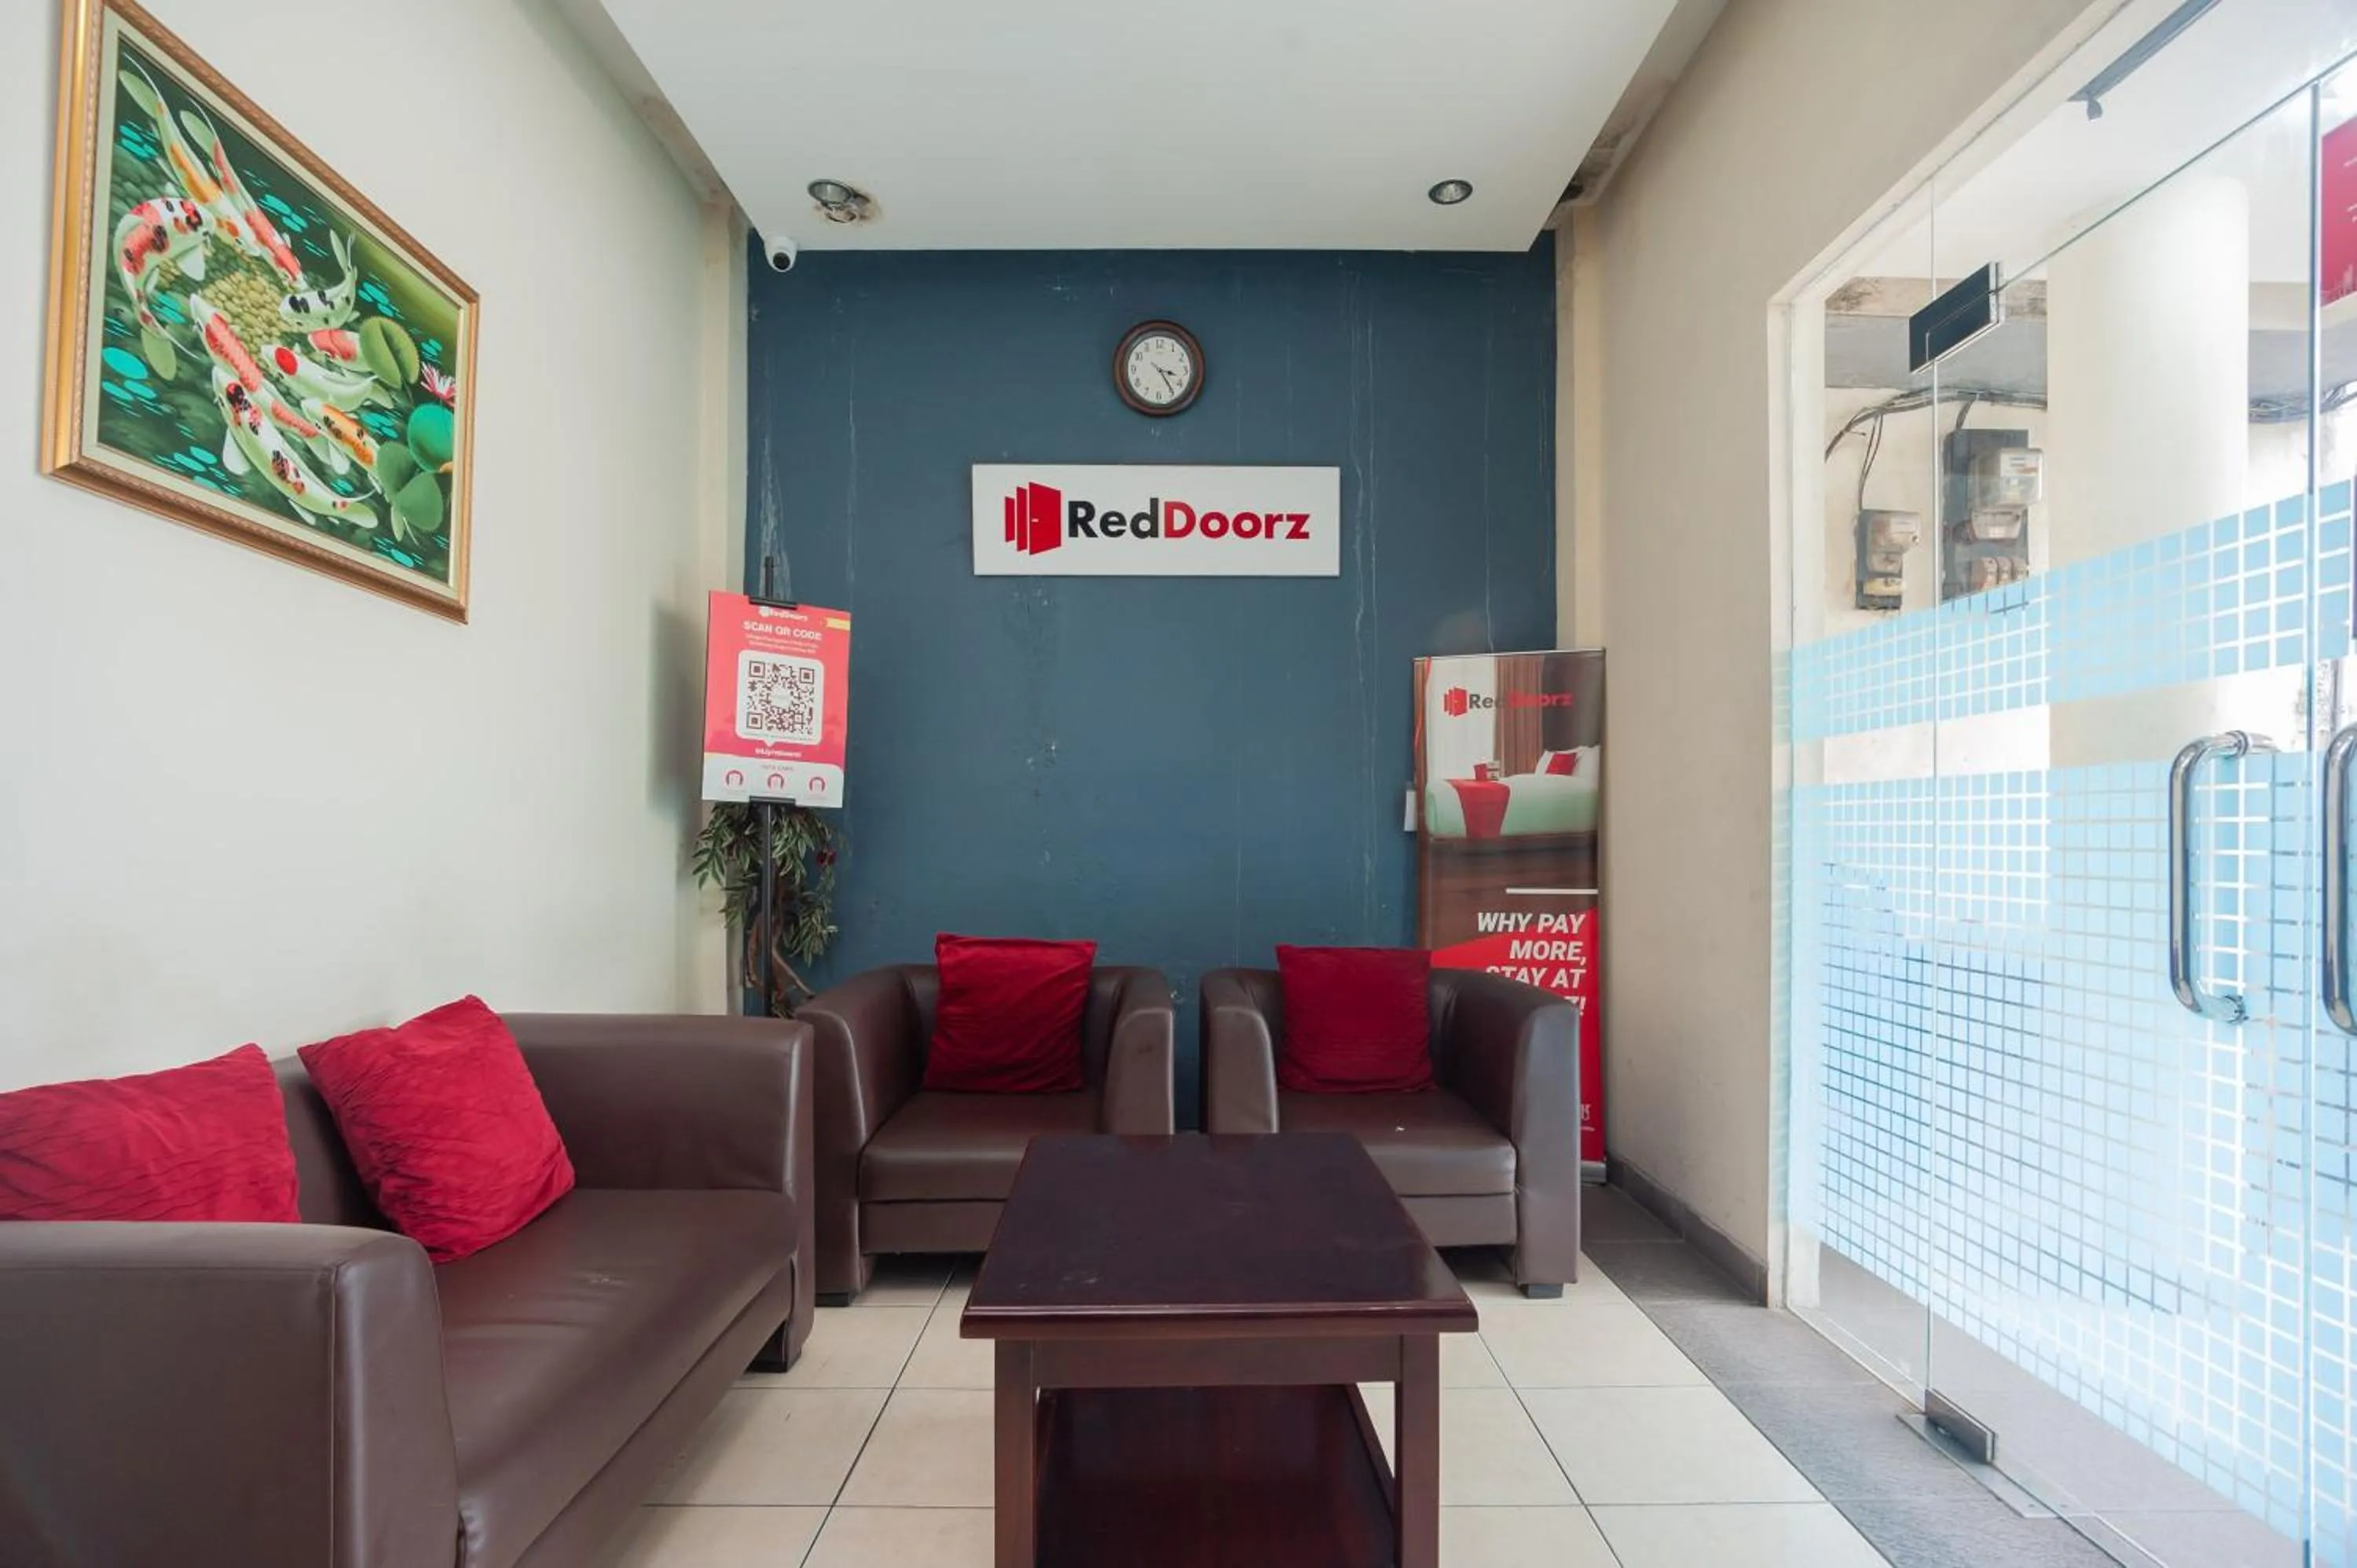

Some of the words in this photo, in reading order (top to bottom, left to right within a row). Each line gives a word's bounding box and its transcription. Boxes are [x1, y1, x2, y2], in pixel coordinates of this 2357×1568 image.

[1068, 497, 1310, 540] RedDoorz
[742, 620, 773, 633] SCAN
[775, 625, 791, 636] QR
[793, 628, 823, 640] CODE
[1477, 912, 1533, 932] WHY
[1537, 914, 1586, 934] PAY
[1509, 940, 1587, 966] MORE,
[1550, 968, 1587, 989] AT
